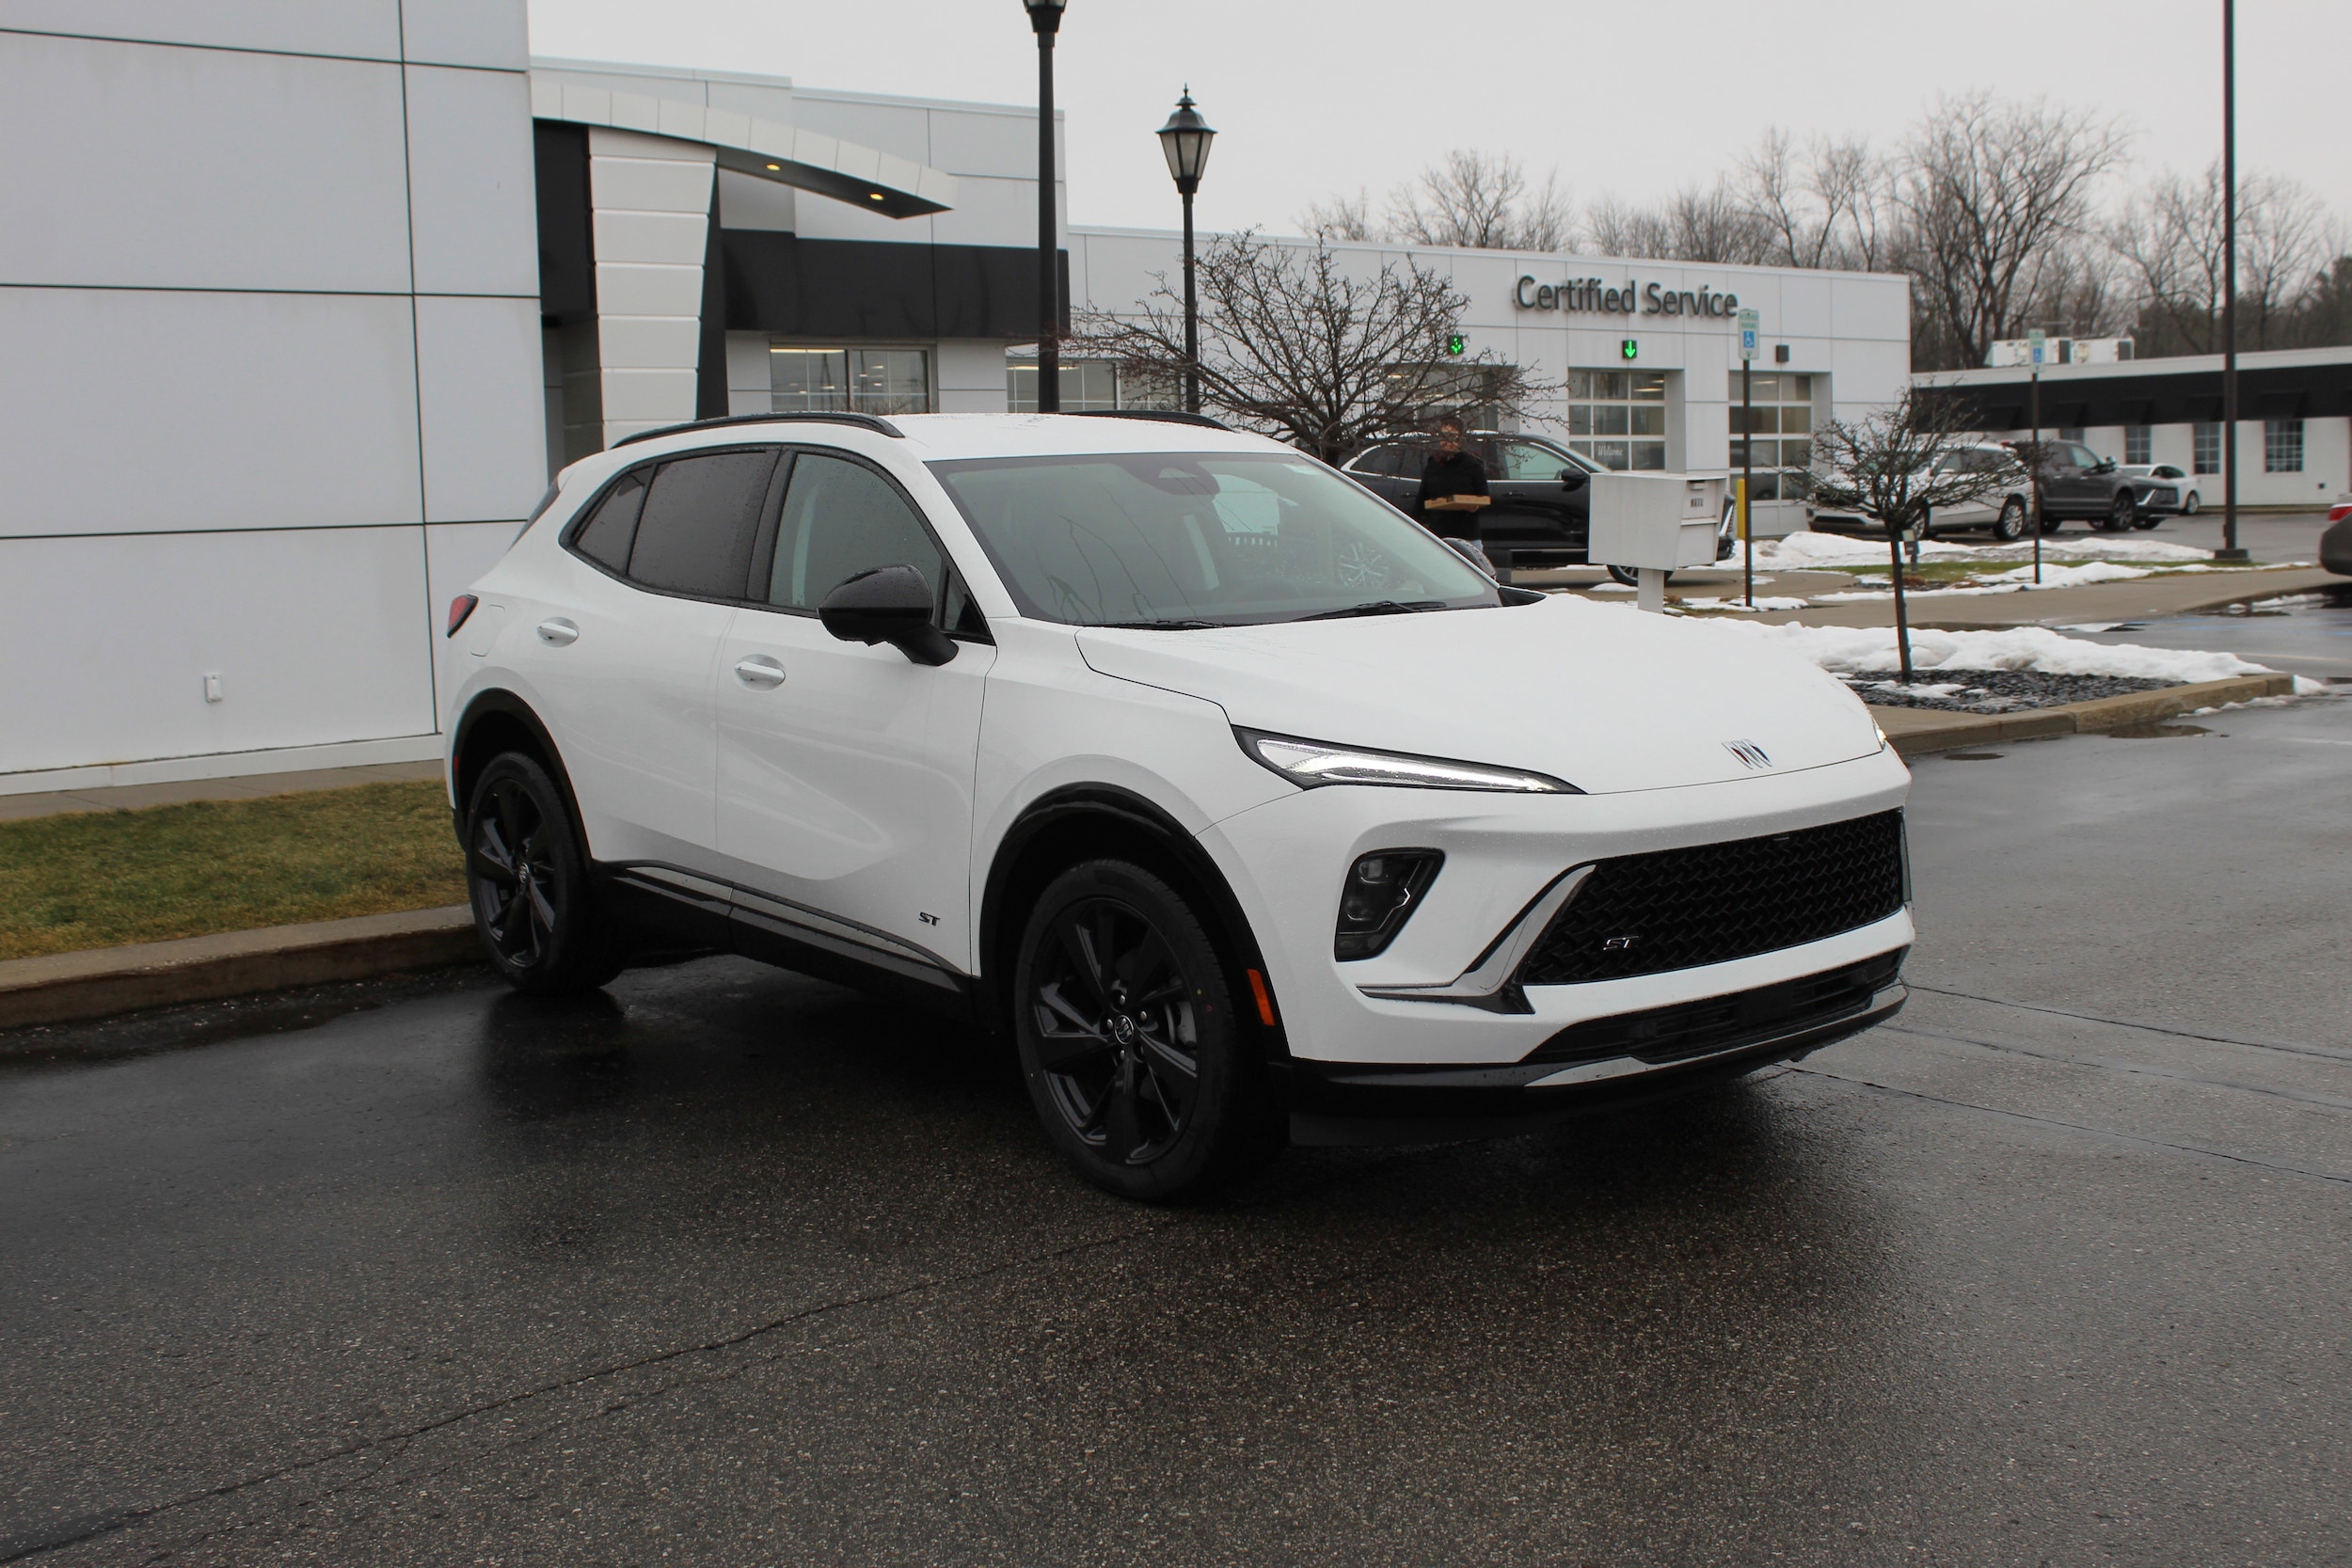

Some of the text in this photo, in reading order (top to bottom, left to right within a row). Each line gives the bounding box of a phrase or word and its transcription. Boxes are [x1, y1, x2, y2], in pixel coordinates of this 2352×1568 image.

[1514, 274, 1739, 318] Certified Service
[918, 911, 941, 927] ST
[1602, 935, 1640, 951] ST
